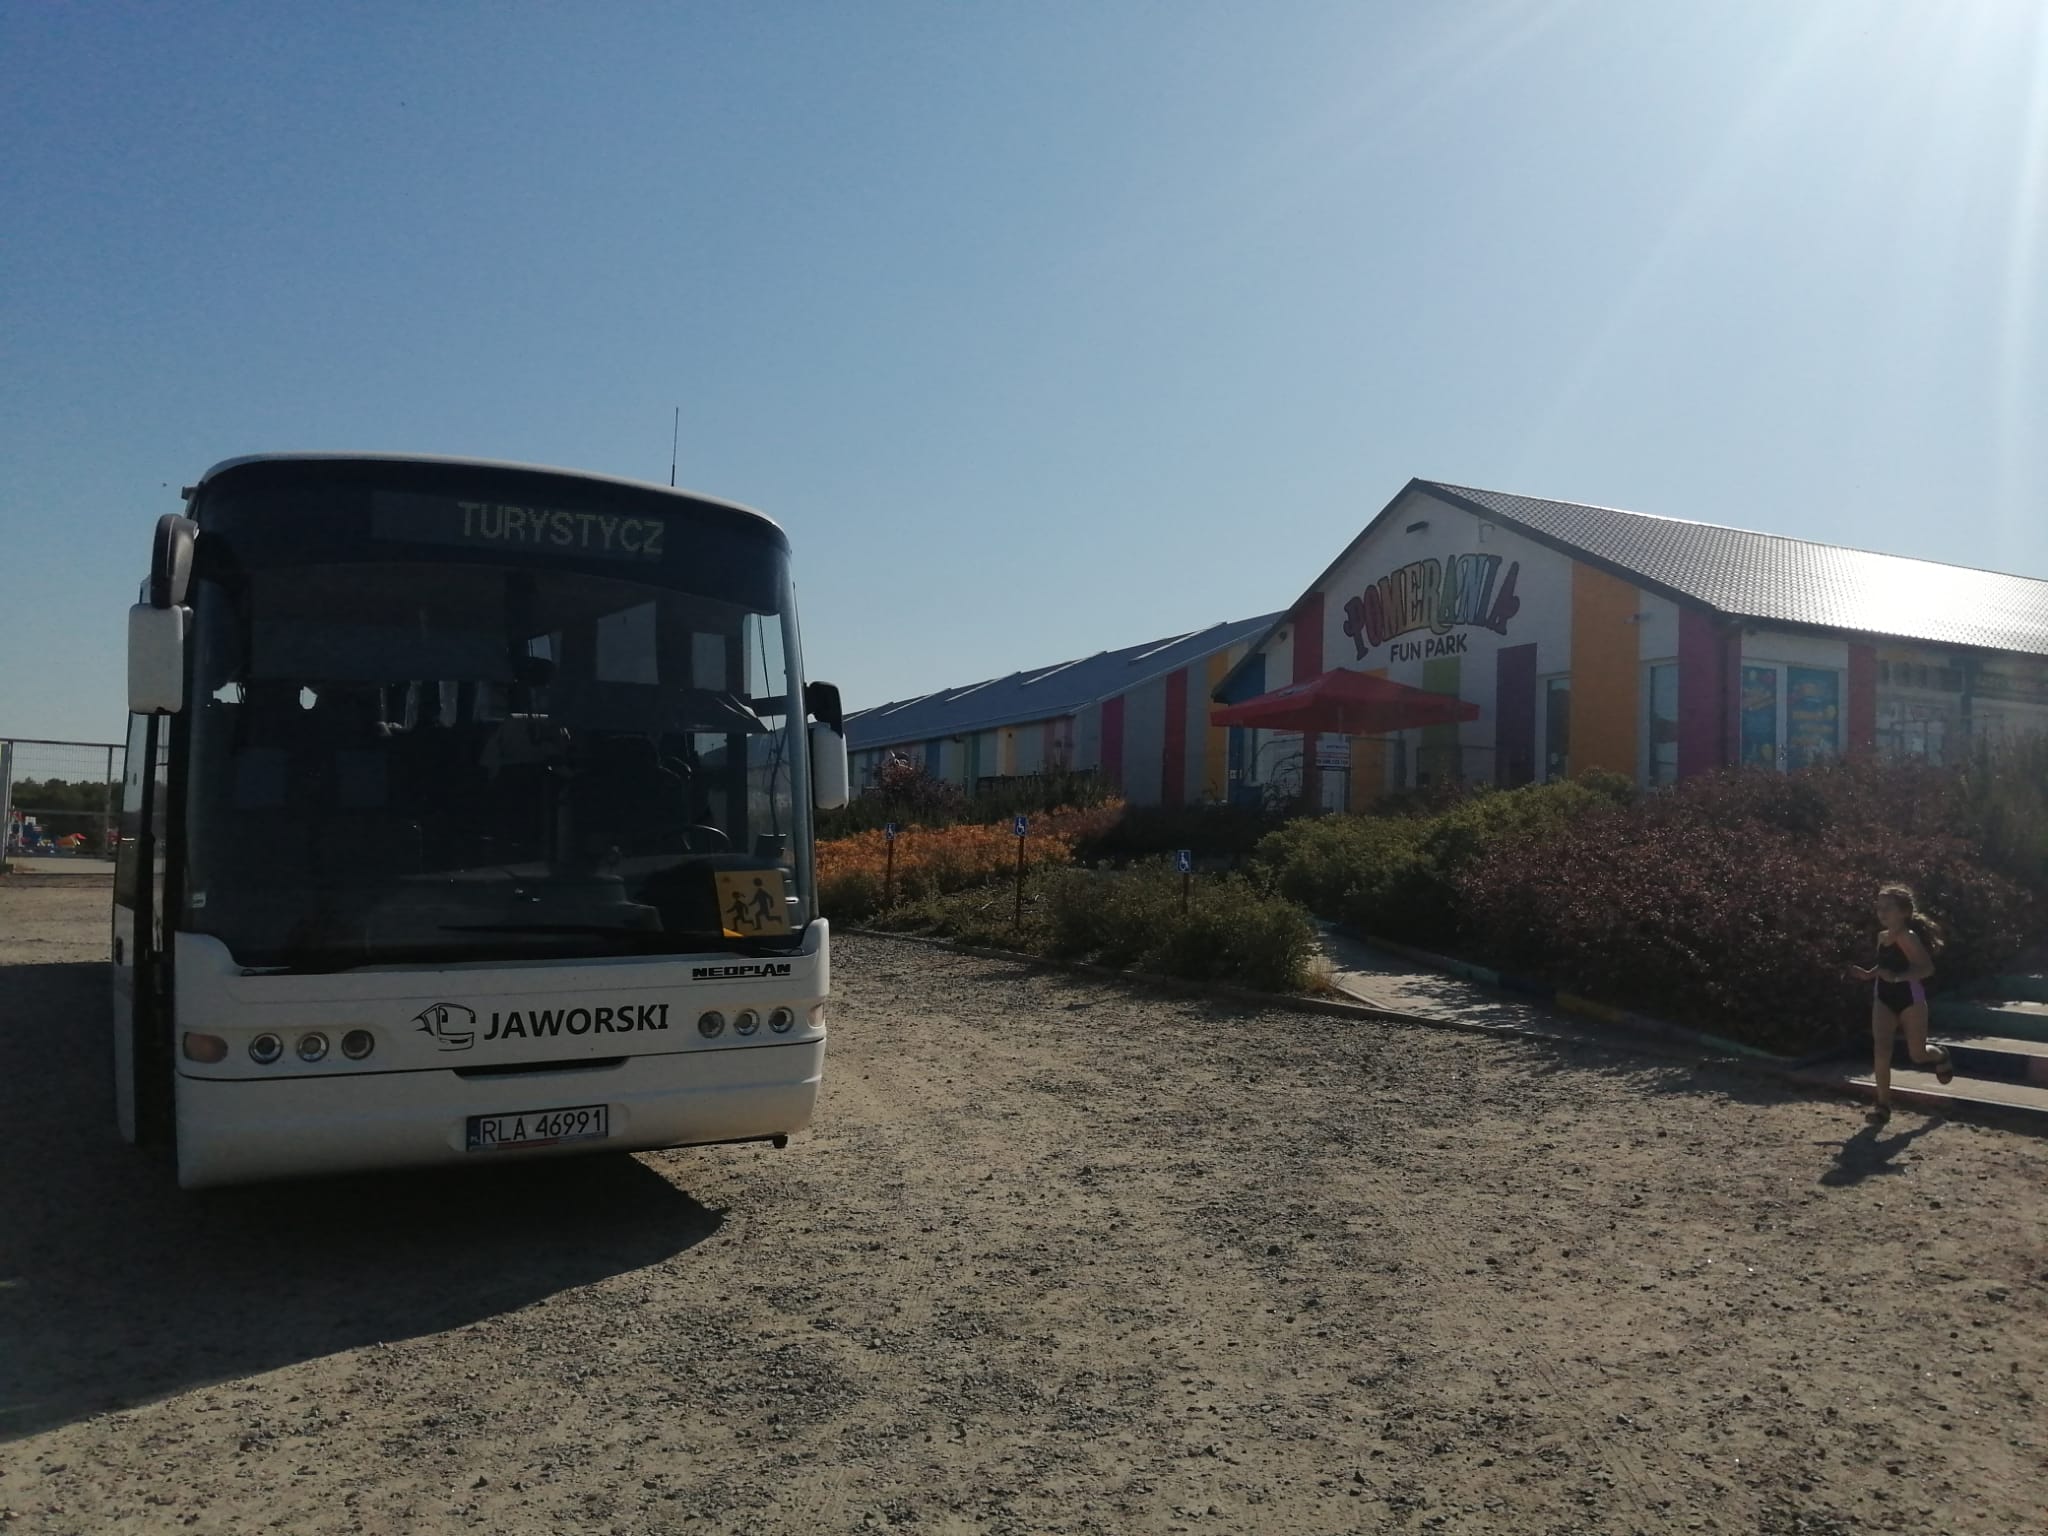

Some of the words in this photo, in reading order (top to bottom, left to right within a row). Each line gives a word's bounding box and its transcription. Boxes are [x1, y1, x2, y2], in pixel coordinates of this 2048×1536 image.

[457, 500, 664, 555] TURYSTYCZ
[1343, 554, 1520, 661] POMERANIA
[1390, 642, 1421, 663] FUN
[1425, 633, 1468, 658] PARK
[692, 964, 791, 979] NEOPLAN
[483, 1003, 669, 1041] JAWORSKI
[482, 1117, 527, 1143] RLA
[535, 1109, 601, 1137] 46991
